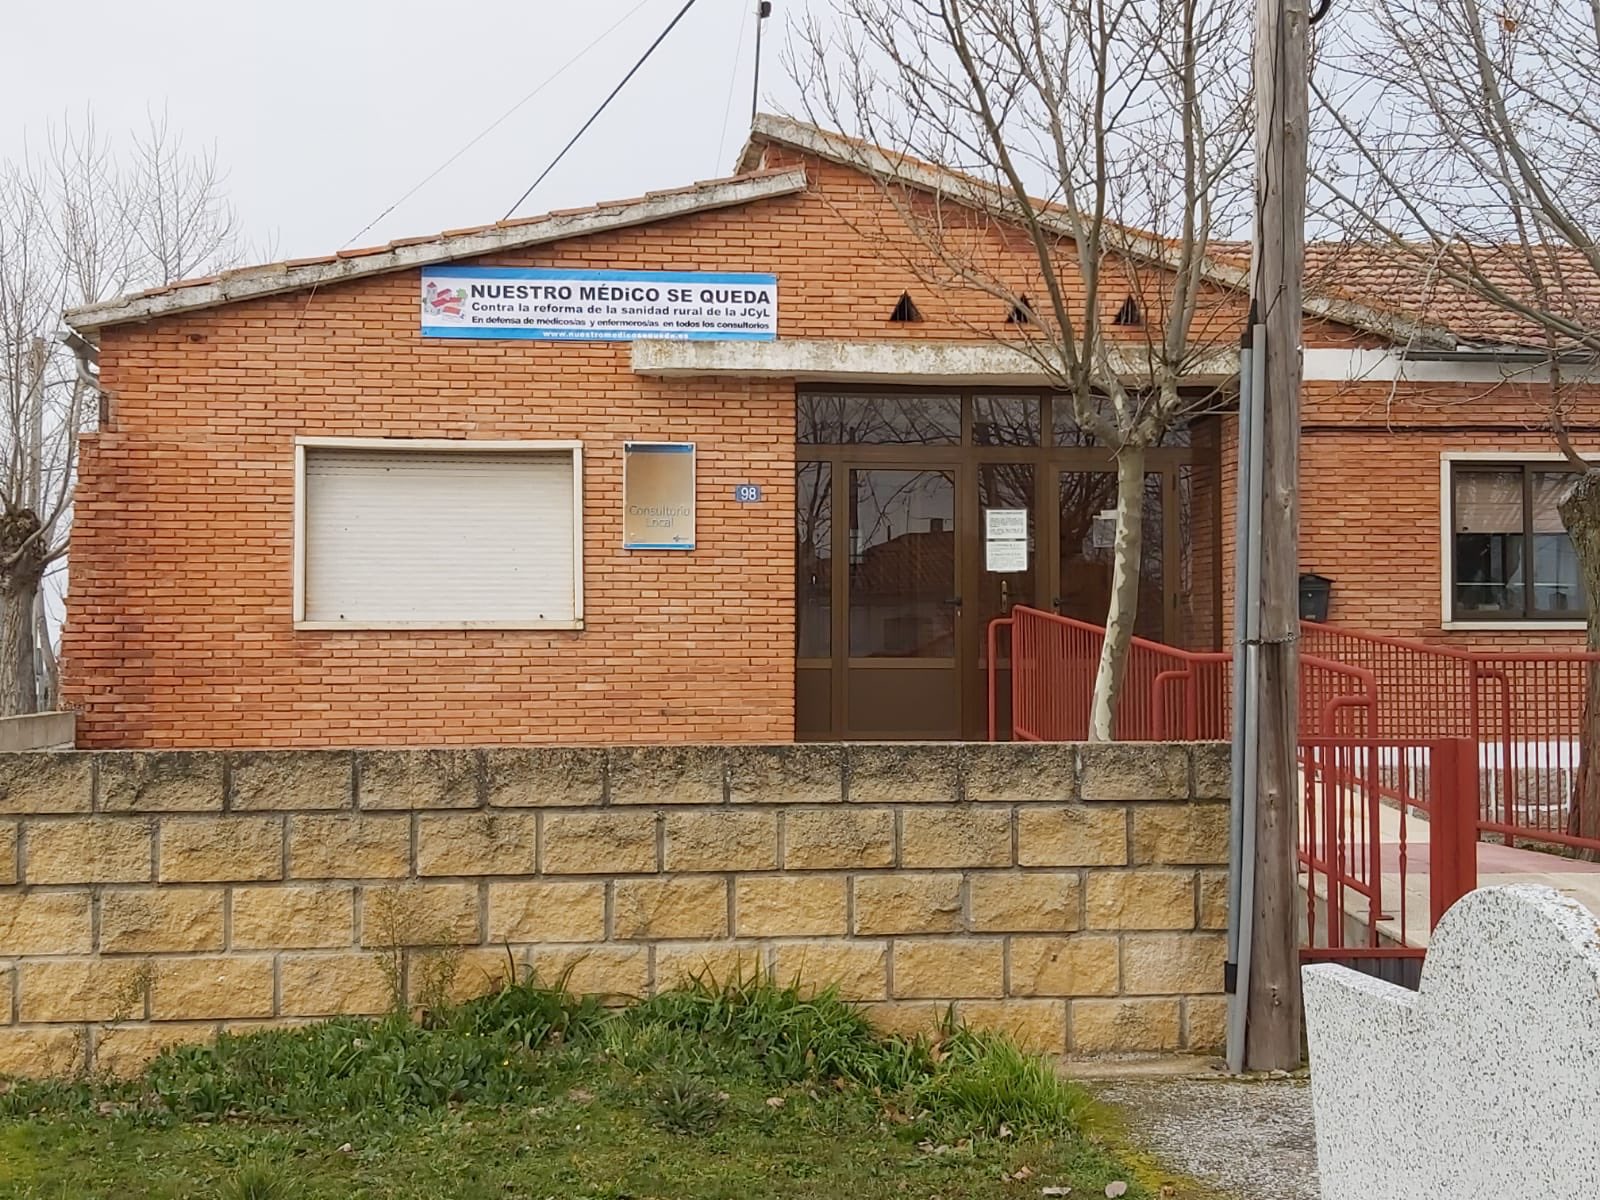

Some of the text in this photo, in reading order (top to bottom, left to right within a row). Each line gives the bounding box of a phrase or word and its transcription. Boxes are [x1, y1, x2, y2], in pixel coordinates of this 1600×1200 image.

[471, 284, 572, 300] NUESTRO
[667, 289, 693, 302] SE
[700, 289, 771, 305] QUEDA
[472, 302, 770, 320] Contra la reforma de la sanidad rural de la JCyL
[472, 316, 484, 324] En
[486, 316, 521, 325] defensa
[523, 316, 535, 325] de
[589, 320, 595, 328] y
[597, 319, 659, 328] enfermeros/as
[676, 320, 700, 328] todos
[702, 320, 715, 329] los
[716, 321, 770, 329] consultorios
[741, 487, 757, 500] 98
[629, 505, 690, 517] Consultorio
[647, 518, 674, 528] Local
